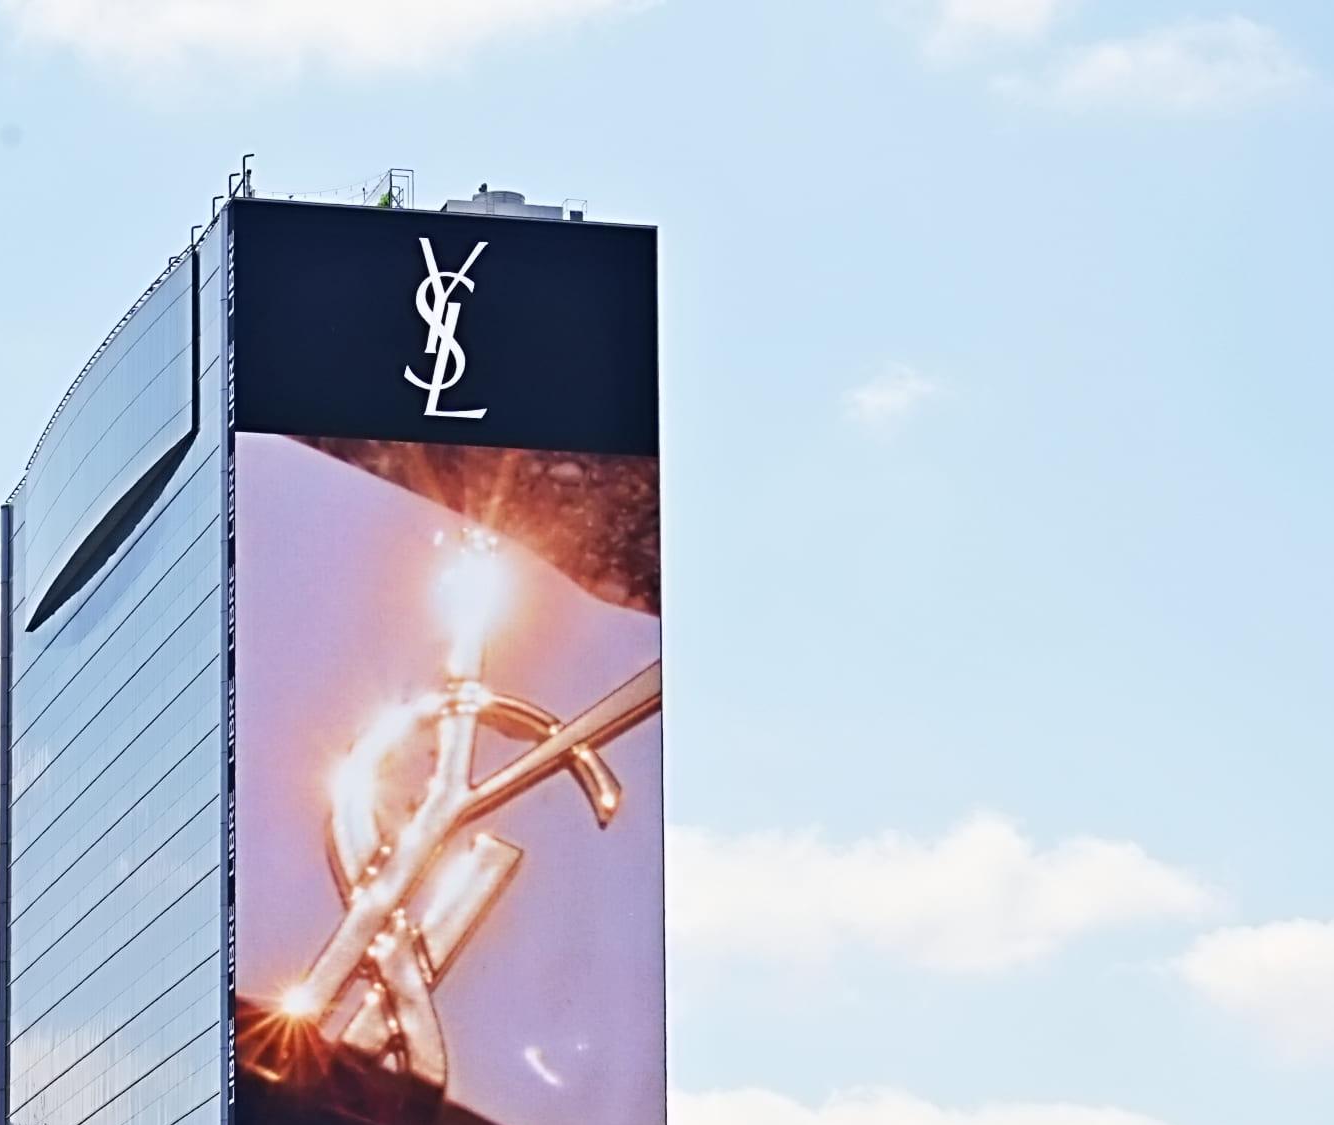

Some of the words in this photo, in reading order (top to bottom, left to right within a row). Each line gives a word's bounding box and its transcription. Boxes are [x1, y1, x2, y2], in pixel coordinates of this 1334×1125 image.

[228, 229, 236, 316] LIBRE
[404, 237, 489, 419] YSL
[228, 340, 236, 428] LIBRE
[228, 454, 236, 540] LIBRE
[228, 564, 236, 651] LIBRE
[228, 679, 236, 763] LIBRE
[228, 792, 236, 876] LIBRE
[228, 903, 236, 990] LIBRE
[228, 1018, 236, 1104] LIBRE
